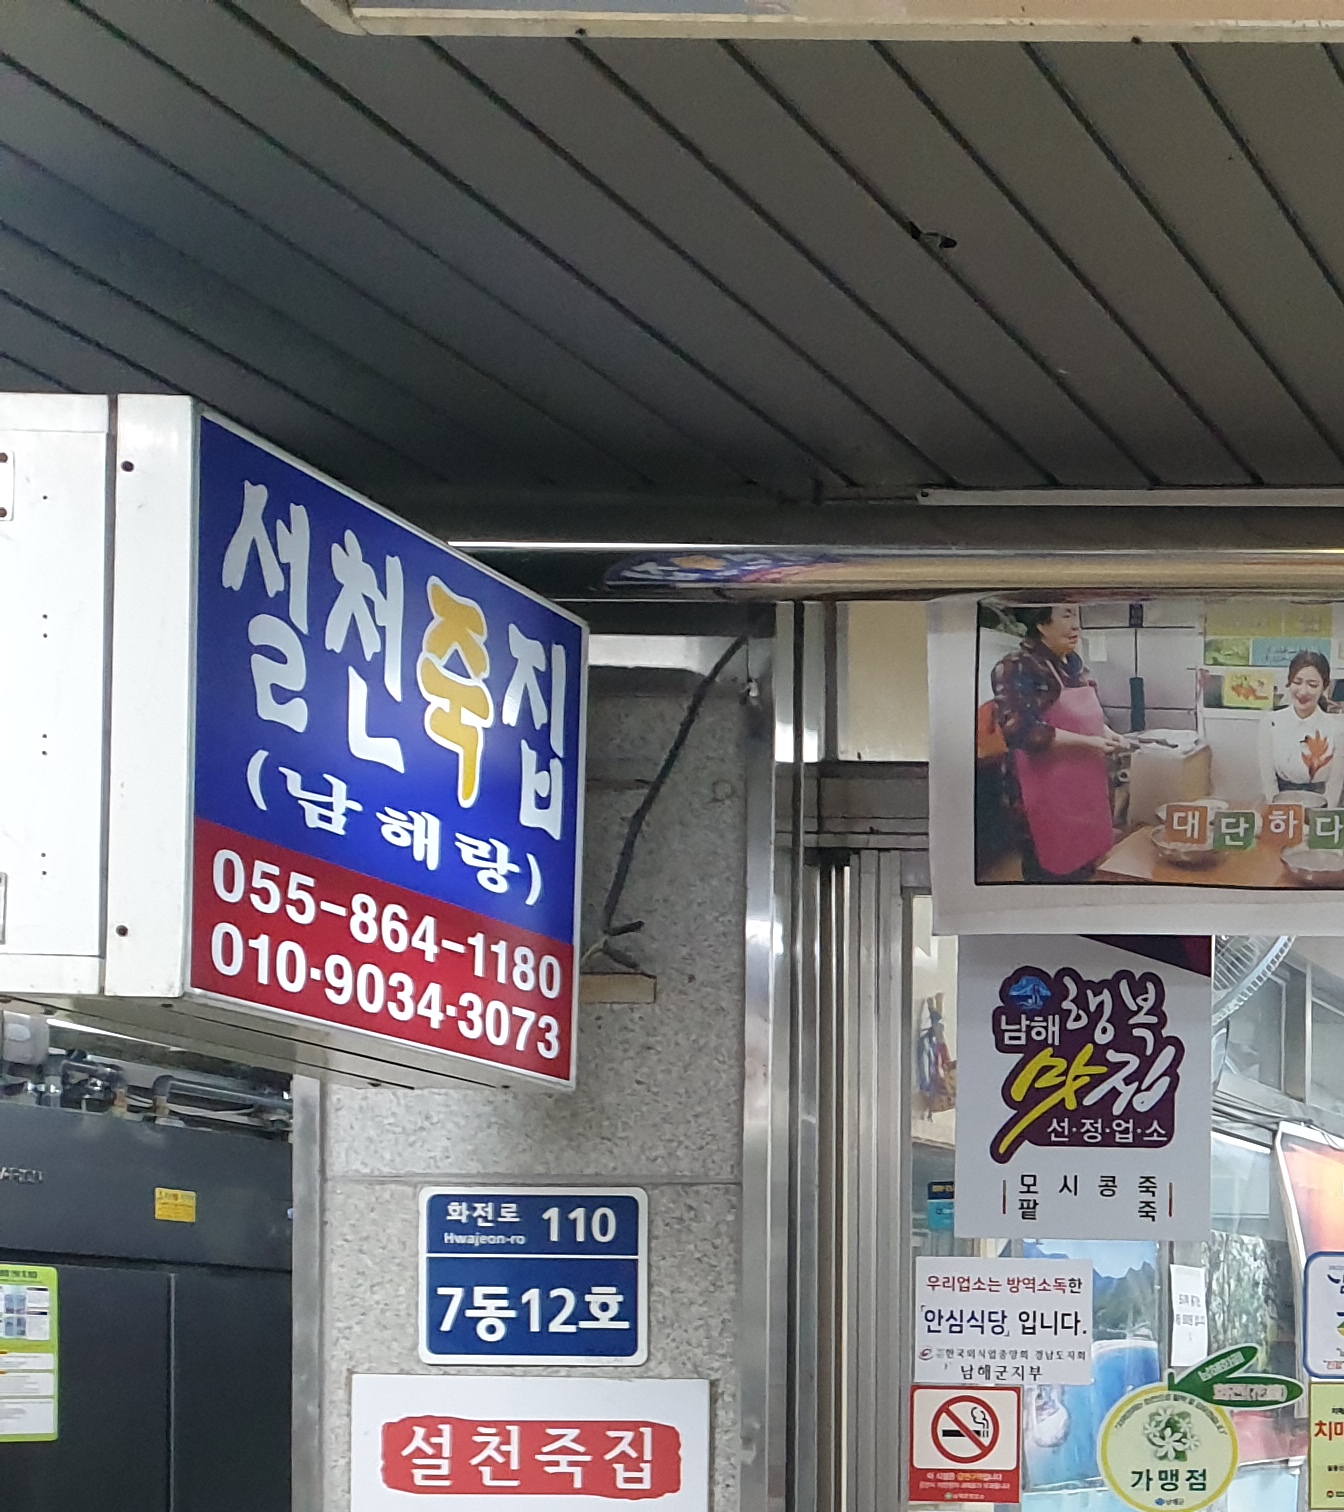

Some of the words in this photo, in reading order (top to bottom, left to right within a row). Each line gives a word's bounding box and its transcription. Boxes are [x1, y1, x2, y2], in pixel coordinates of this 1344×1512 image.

[222, 480, 567, 840] 설천죽집
[1172, 810, 1344, 848] 대단하다
[212, 849, 562, 1000] 055-864-1180
[1000, 1014, 1061, 1046] 남해
[1061, 975, 1159, 1056] 행복
[444, 1232, 527, 1247] Hwajeon-ro
[446, 1202, 522, 1227] 화전로
[542, 1207, 617, 1242] 110
[926, 1275, 1003, 1293] 우리업소는
[1006, 1276, 1083, 1294] 방역소독한
[436, 1286, 631, 1342] 7동12호
[1018, 1310, 1088, 1336] 입니다.
[960, 1364, 1043, 1382] 남해군지부
[400, 1423, 653, 1490] 설천죽집
[1130, 1469, 1208, 1492] 가맹점
